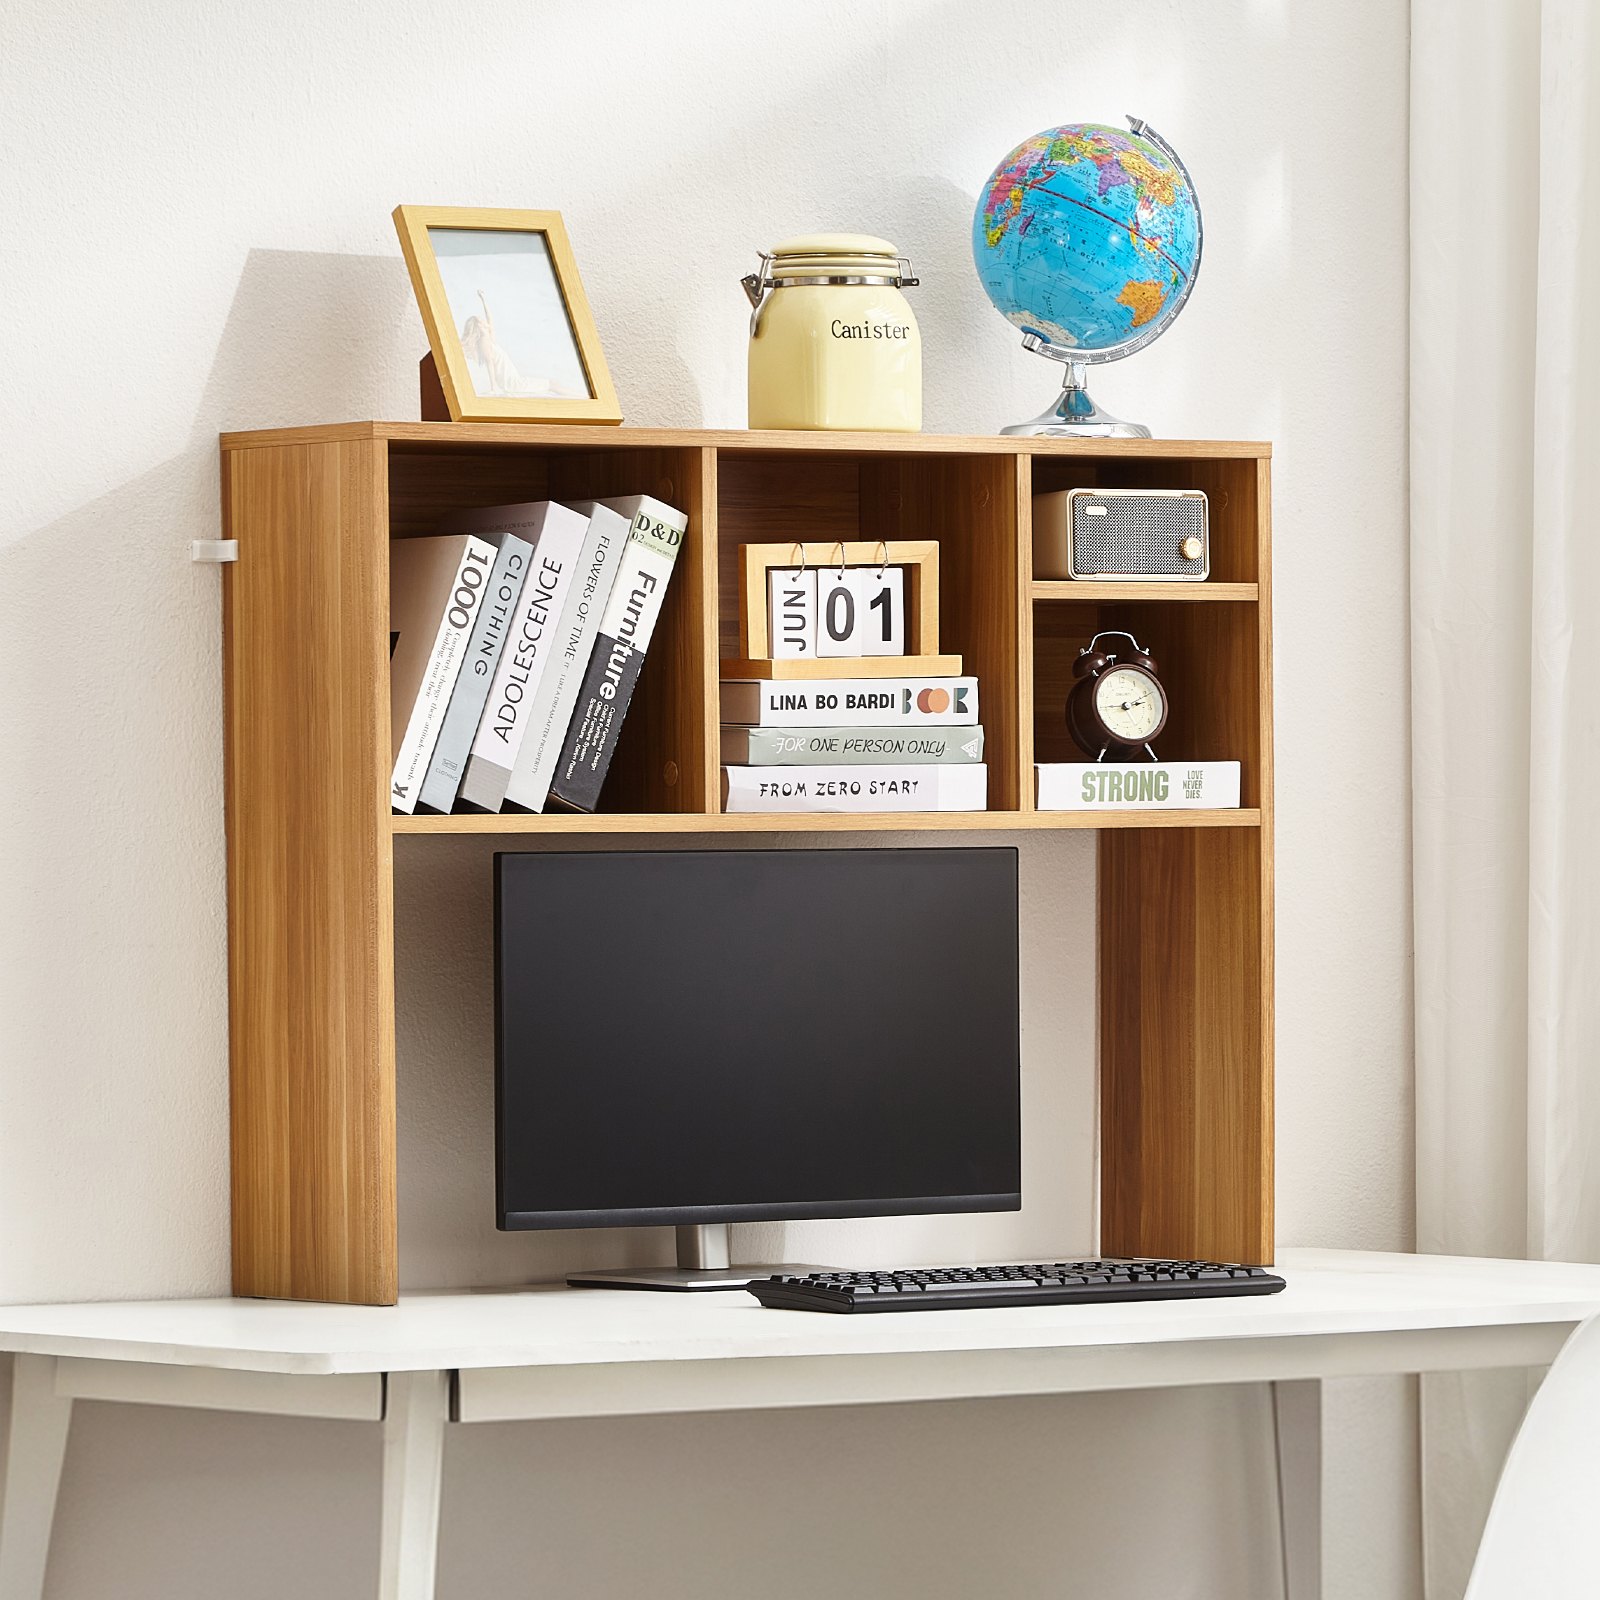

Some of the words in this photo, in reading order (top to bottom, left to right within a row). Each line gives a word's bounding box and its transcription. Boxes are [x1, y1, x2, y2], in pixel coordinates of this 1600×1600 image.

[831, 319, 910, 340] Canister
[632, 532, 645, 544] 02
[583, 535, 611, 601] FLOWERS
[448, 548, 489, 630] 1000
[474, 554, 523, 677] CLOTHING
[576, 602, 590, 624] OF
[783, 590, 807, 651] JUN
[564, 626, 583, 661] TIME
[599, 570, 659, 700] Furniture
[493, 557, 563, 743] ADOLESCENCE
[549, 696, 560, 719] DREAM
[770, 694, 808, 711] LINA
[815, 694, 838, 710] BO
[845, 693, 895, 710] BARDI
[543, 719, 552, 739] AFTER
[531, 739, 547, 775] PROSPERITY
[809, 737, 839, 752] ONE
[842, 737, 905, 754] PERSON
[1082, 770, 1169, 802] STRONG
[1183, 780, 1203, 789] NEVER
[1187, 770, 1204, 780] LOVE
[759, 782, 807, 798] FROM
[816, 780, 861, 796] ZERO
[869, 779, 919, 795] START
